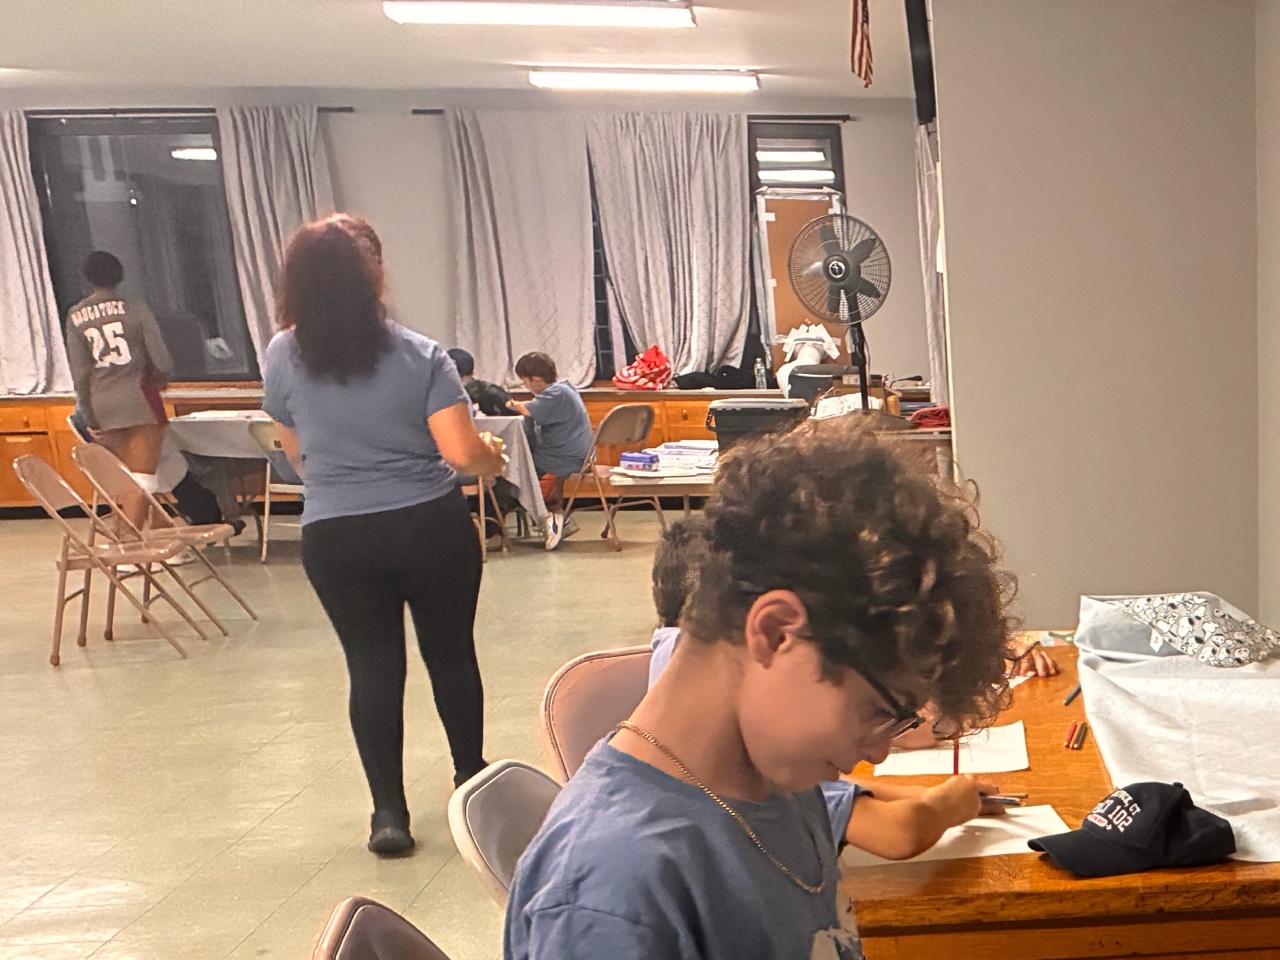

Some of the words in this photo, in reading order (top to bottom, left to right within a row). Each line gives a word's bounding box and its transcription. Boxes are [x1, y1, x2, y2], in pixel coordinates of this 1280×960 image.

[84, 322, 132, 368] 25
[1108, 805, 1133, 832] 102
[1129, 803, 1141, 816] CT
